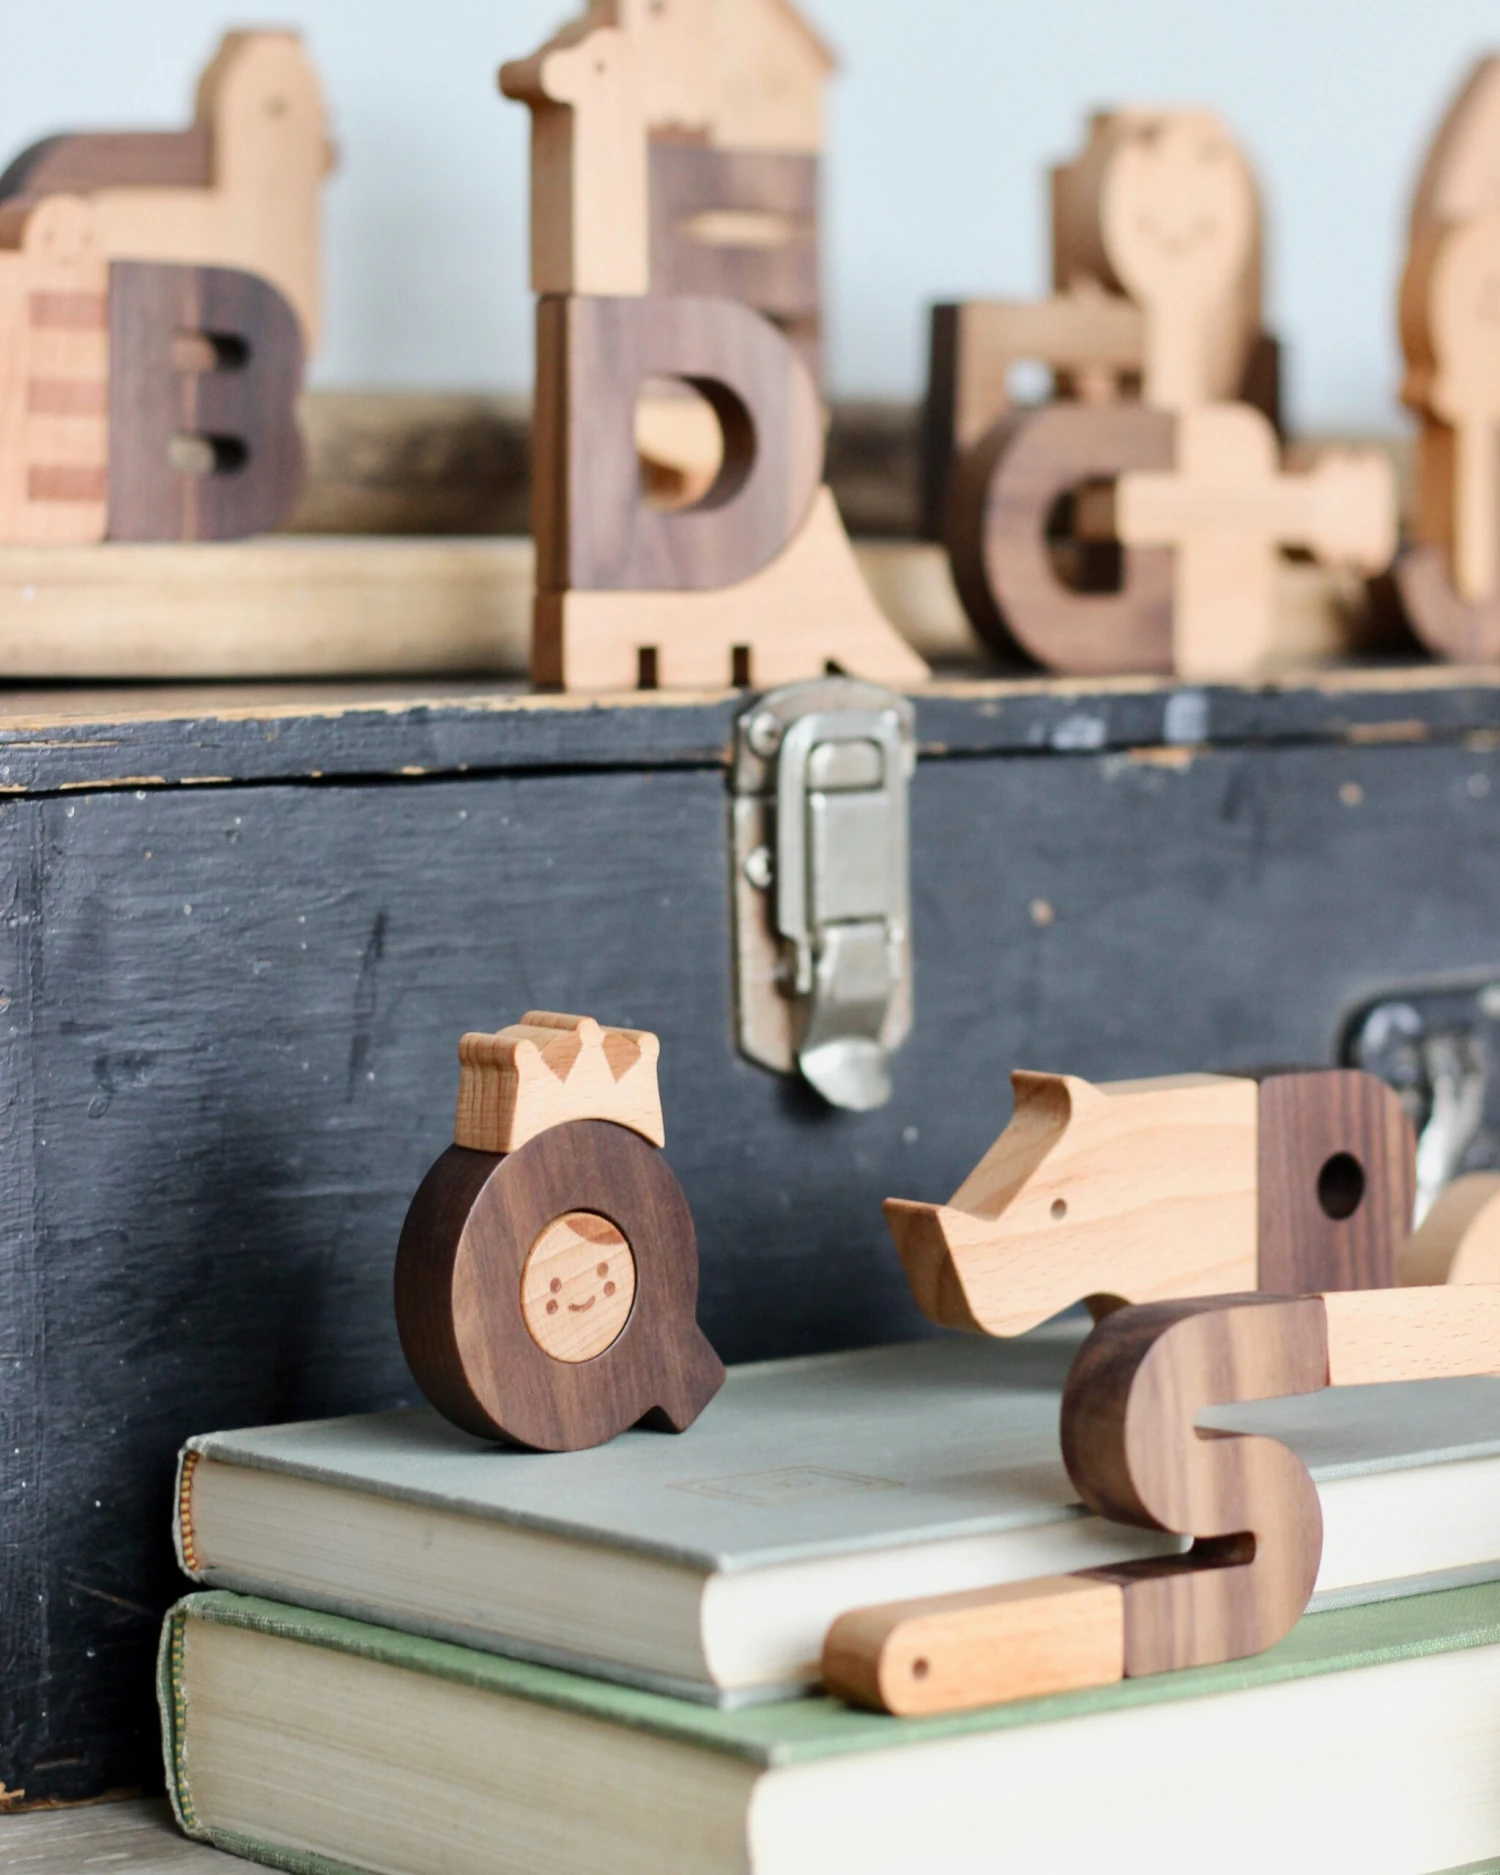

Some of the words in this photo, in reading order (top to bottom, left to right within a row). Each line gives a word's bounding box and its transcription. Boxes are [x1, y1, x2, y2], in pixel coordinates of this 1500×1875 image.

[562, 294, 824, 593] D
[446, 1117, 727, 1453] Q
[1100, 1297, 1324, 1679] S
